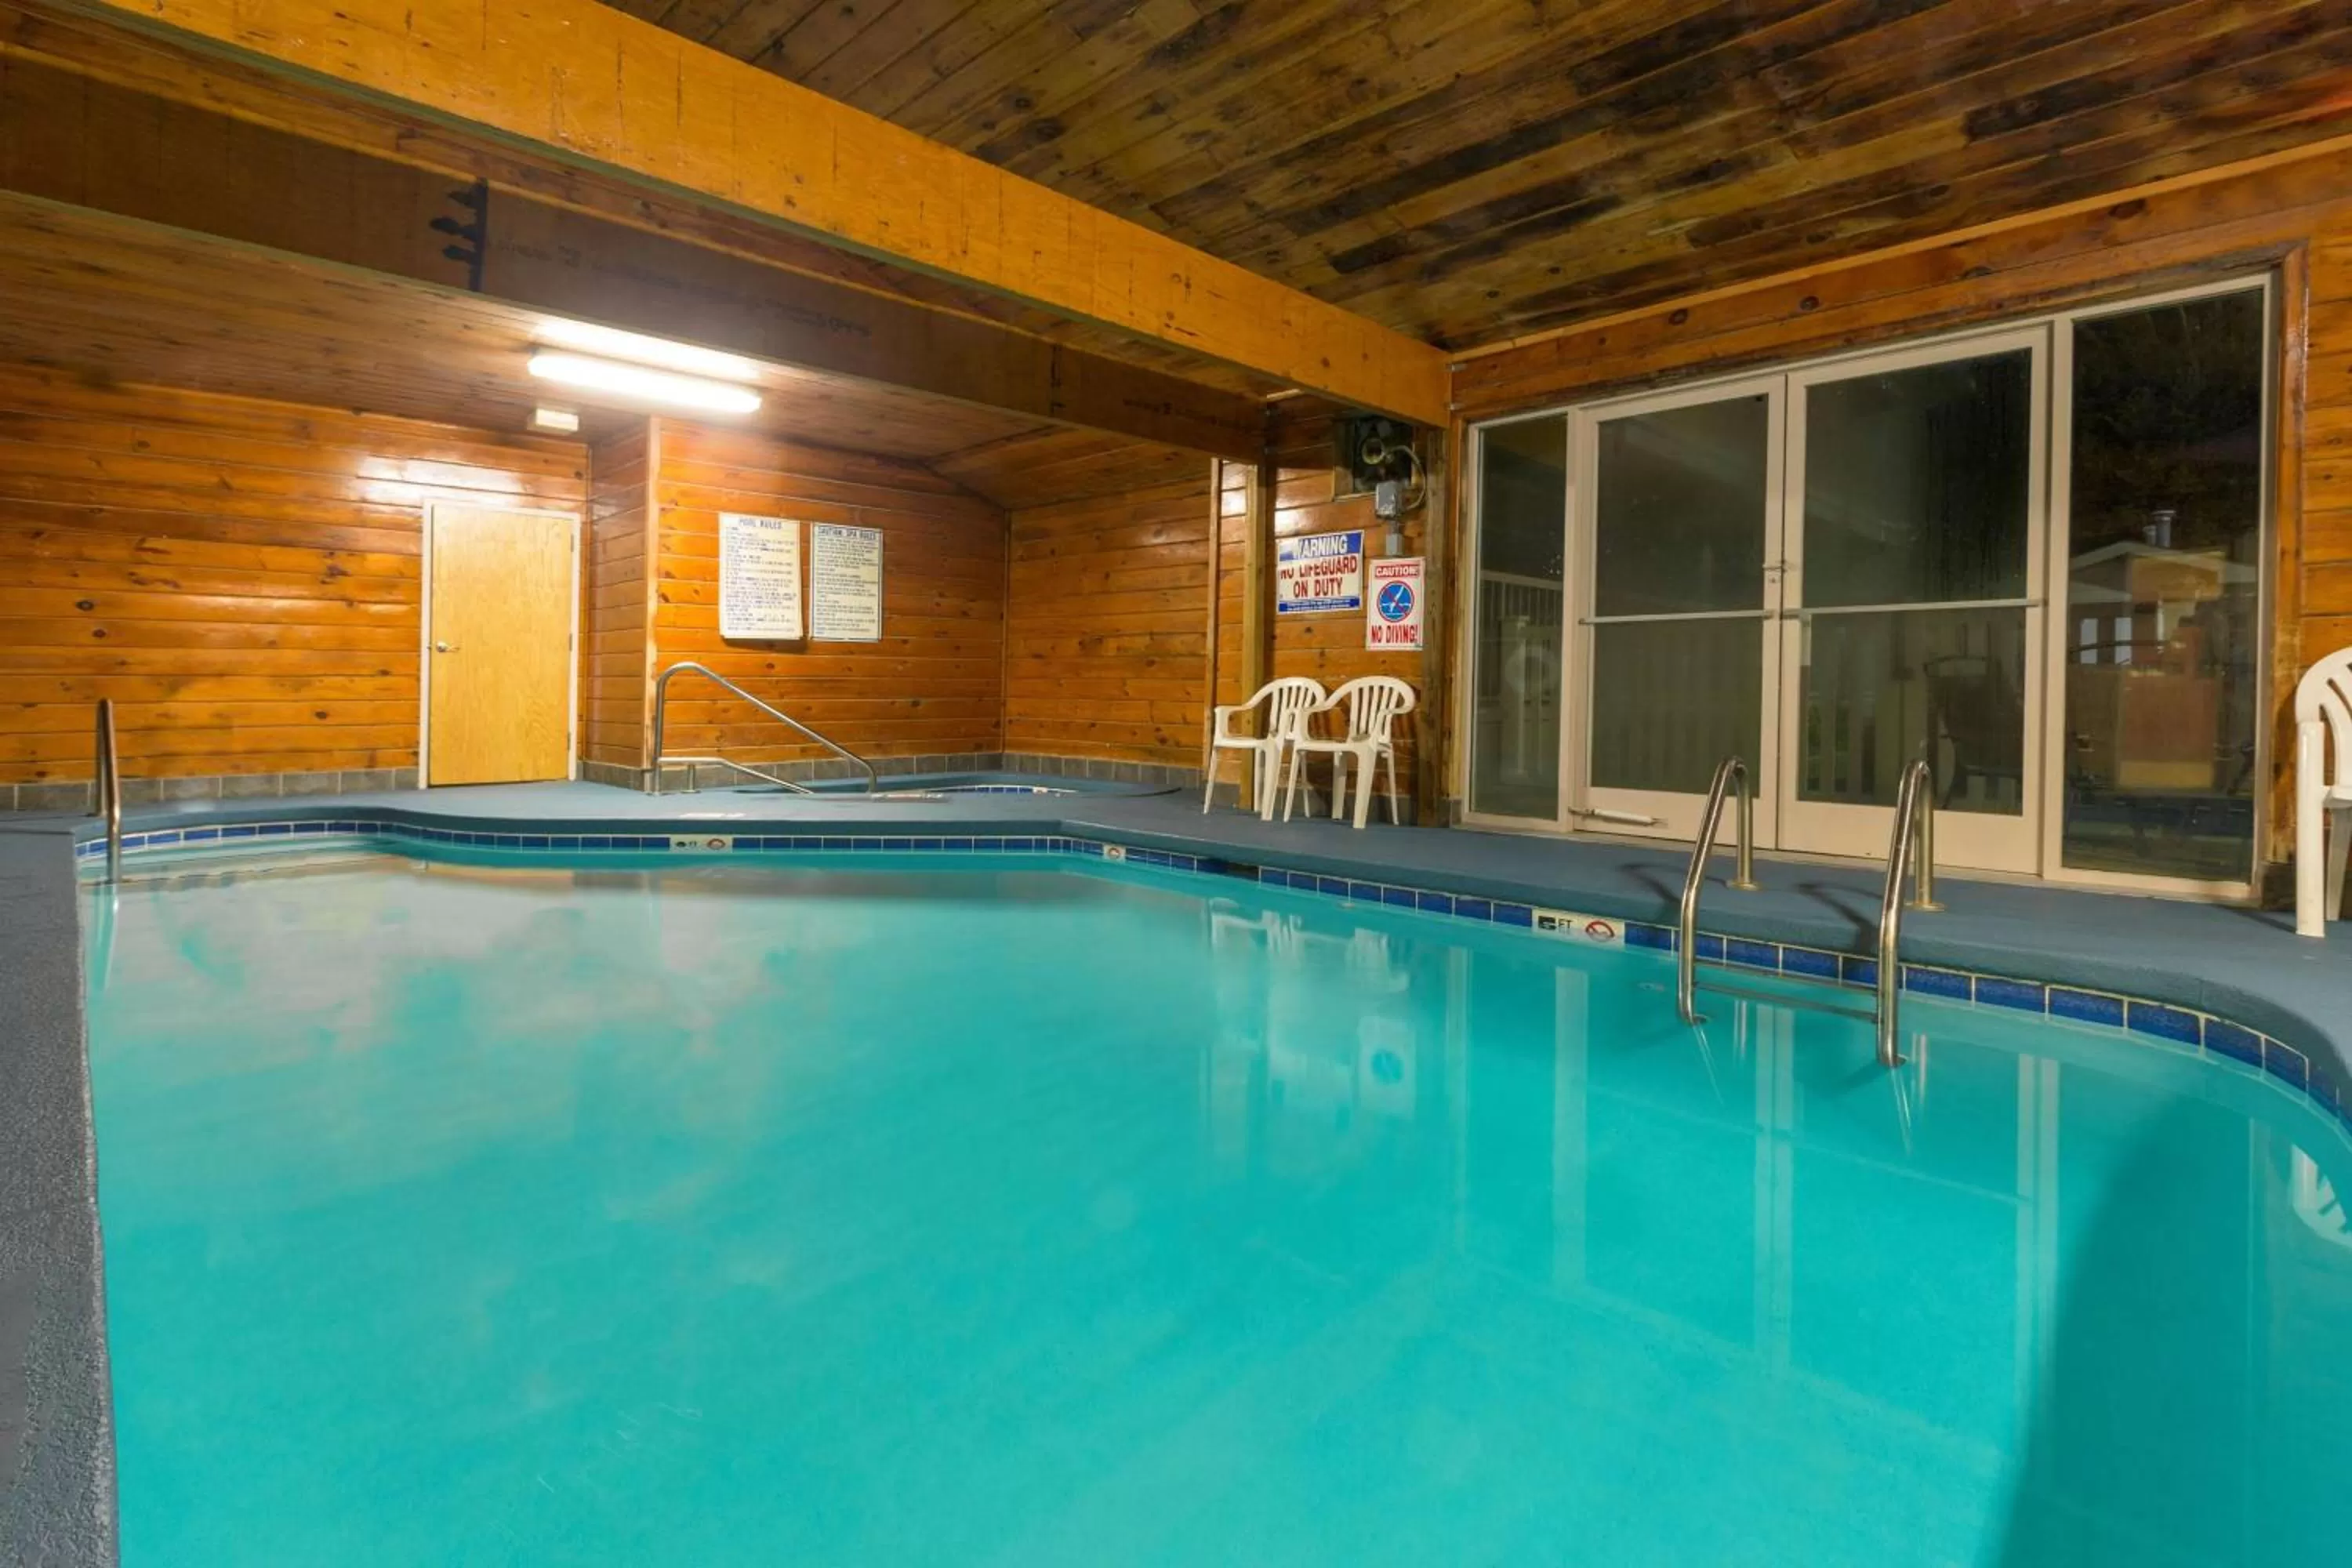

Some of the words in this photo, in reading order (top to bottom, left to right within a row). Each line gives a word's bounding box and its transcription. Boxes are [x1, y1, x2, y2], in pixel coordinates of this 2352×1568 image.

[1299, 555, 1357, 578] LIFEGUARD
[1294, 581, 1308, 598] ON
[1314, 576, 1343, 597] DUTY
[1371, 625, 1382, 644] NO
[1385, 624, 1418, 644] DIVING!
